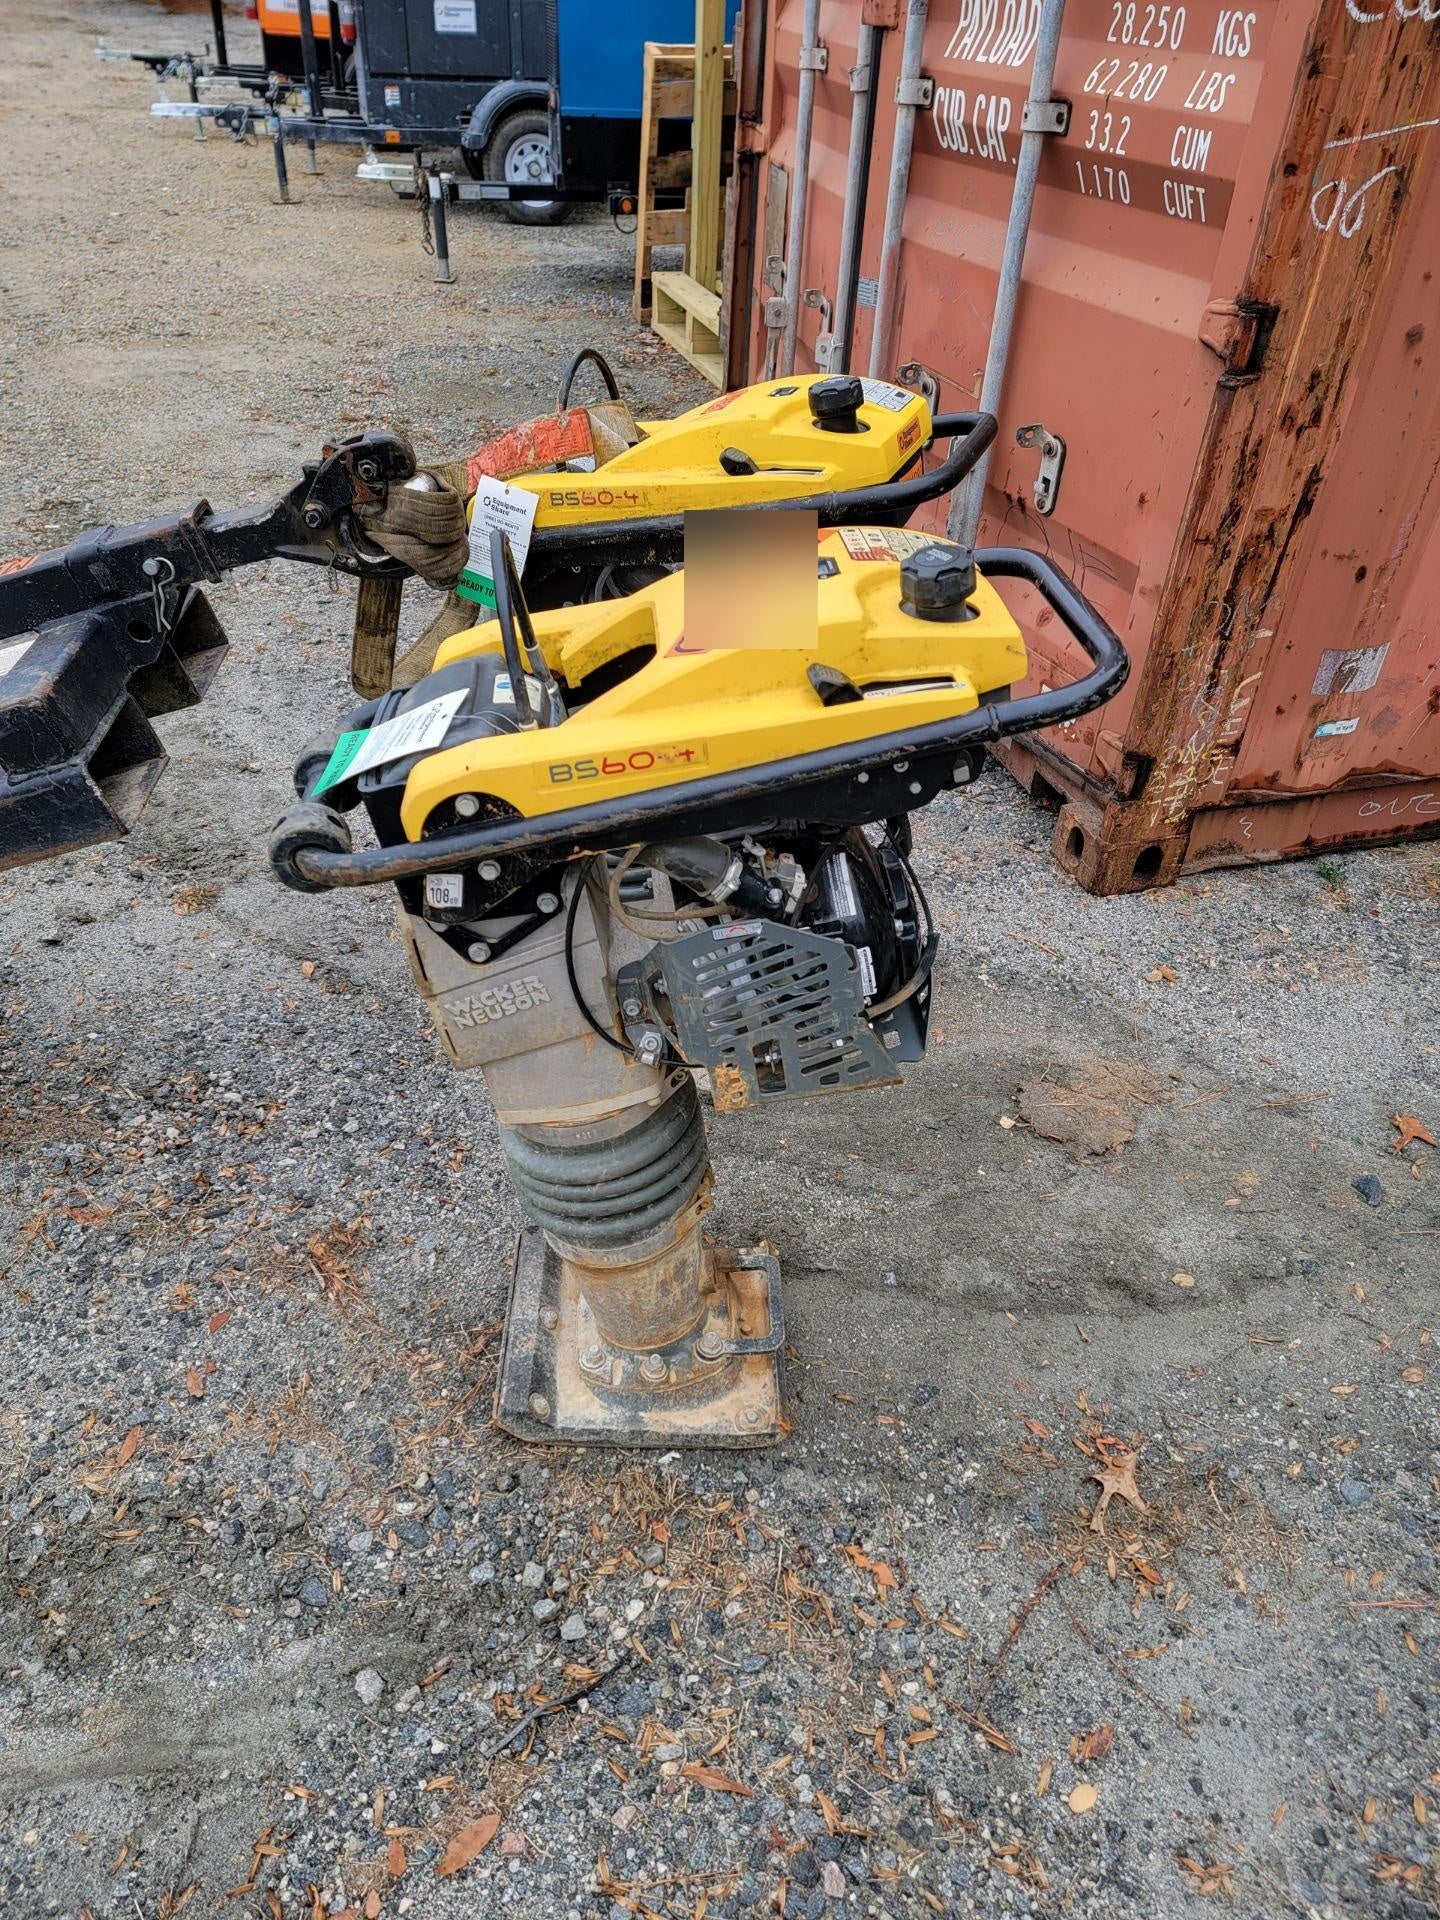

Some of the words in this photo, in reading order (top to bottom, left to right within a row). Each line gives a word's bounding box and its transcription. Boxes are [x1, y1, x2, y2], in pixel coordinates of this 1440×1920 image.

[943, 0, 1042, 67] PAYLOAD
[1211, 10, 1257, 58] KGS
[1183, 70, 1236, 113] LBS
[1085, 109, 1131, 156] 33.2
[1170, 125, 1213, 172] CUM
[1163, 179, 1206, 223] CUFT
[490, 504, 510, 516] Share
[492, 497, 527, 516] Equipment
[549, 490, 639, 507] BS60-4
[461, 578, 484, 593] READY
[485, 586, 494, 598] TO
[429, 887, 450, 905] 108
[443, 975, 545, 1017] WACKER
[454, 982, 552, 1030] NEUSON
